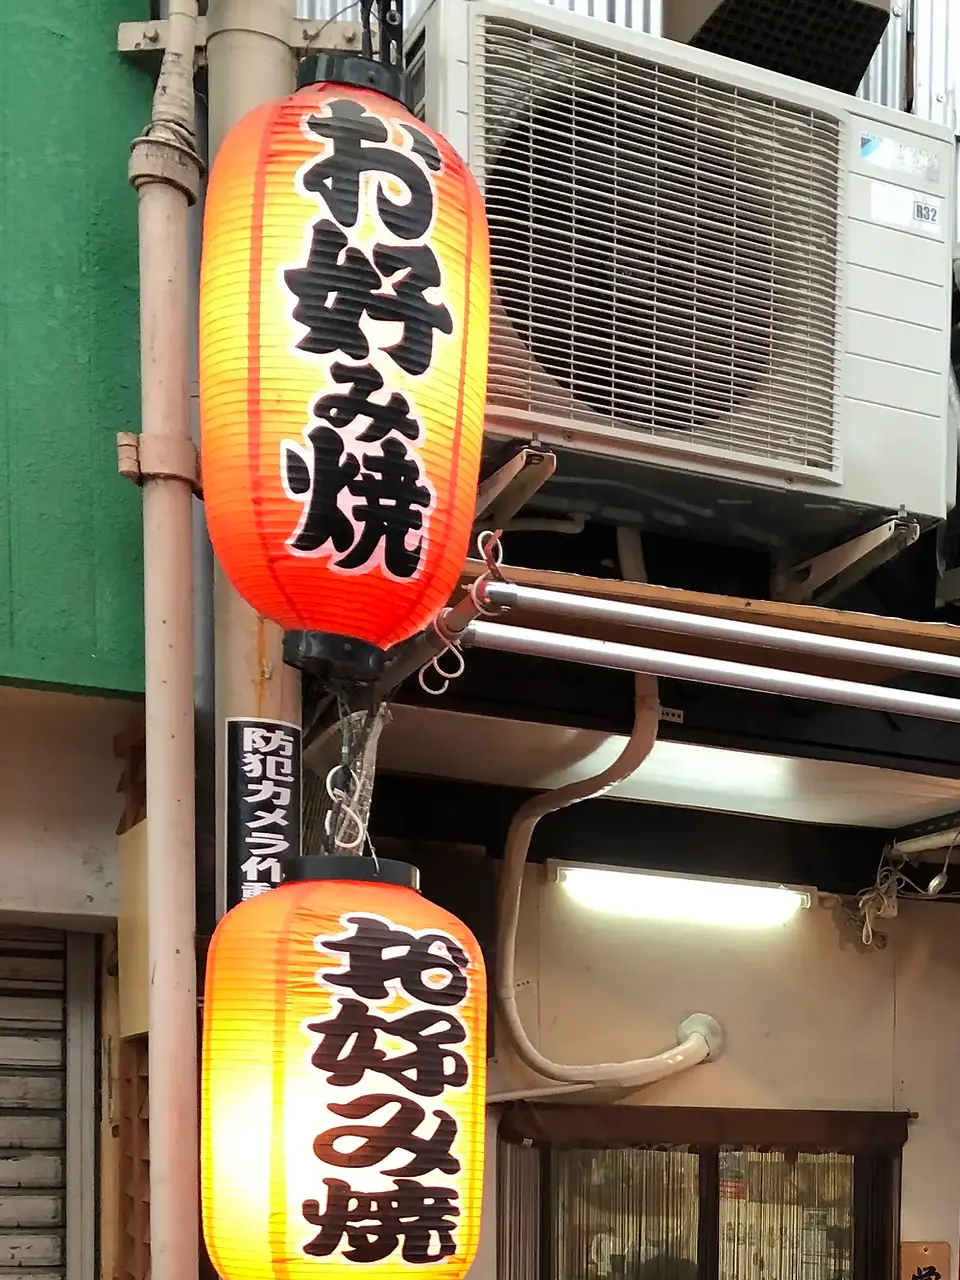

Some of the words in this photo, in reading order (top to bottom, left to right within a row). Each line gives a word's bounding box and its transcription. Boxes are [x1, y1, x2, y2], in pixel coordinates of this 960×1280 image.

[284, 98, 452, 580] お好み焼
[916, 204, 937, 222] R32
[302, 916, 469, 1263] お好み焼
